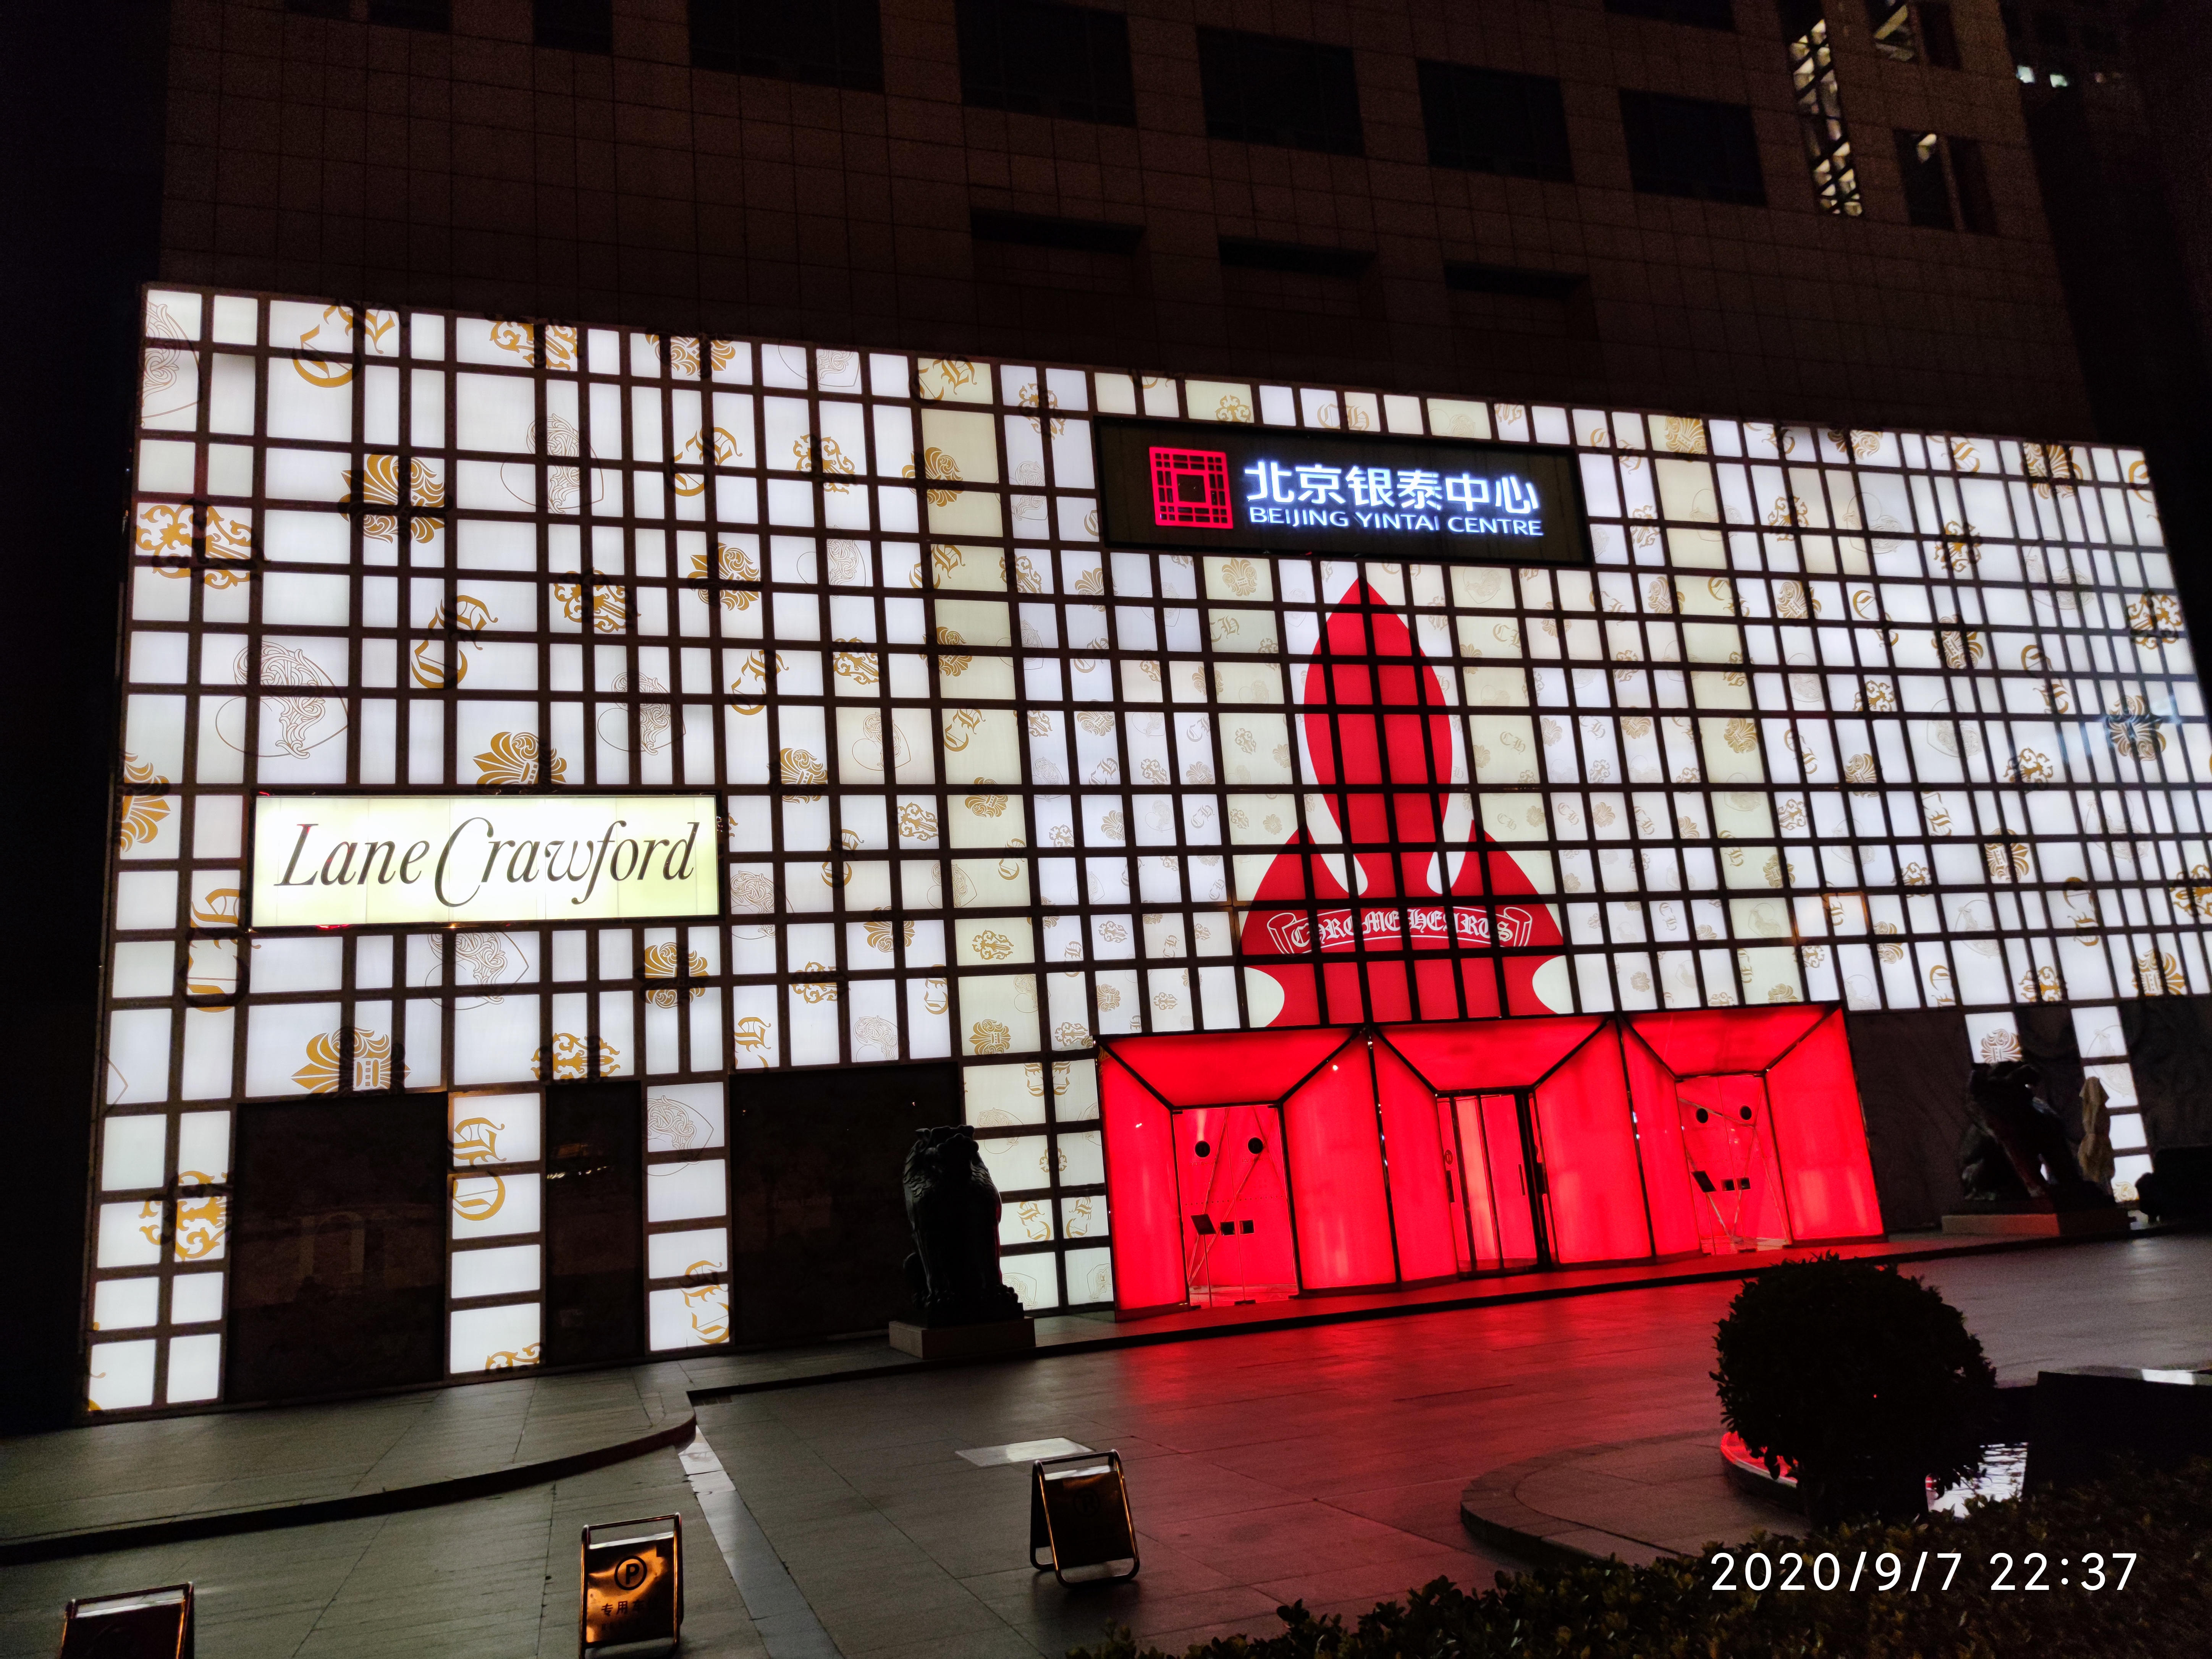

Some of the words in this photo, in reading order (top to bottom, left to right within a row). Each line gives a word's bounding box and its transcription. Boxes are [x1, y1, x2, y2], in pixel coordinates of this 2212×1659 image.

[1244, 460, 1538, 514] 北京银泰中心
[1249, 506, 1350, 527] BEIJING
[1355, 512, 1439, 531] YINTAI
[1448, 516, 1543, 536] CENTRE
[273, 823, 429, 885] Lane
[435, 817, 700, 907] Crawford
